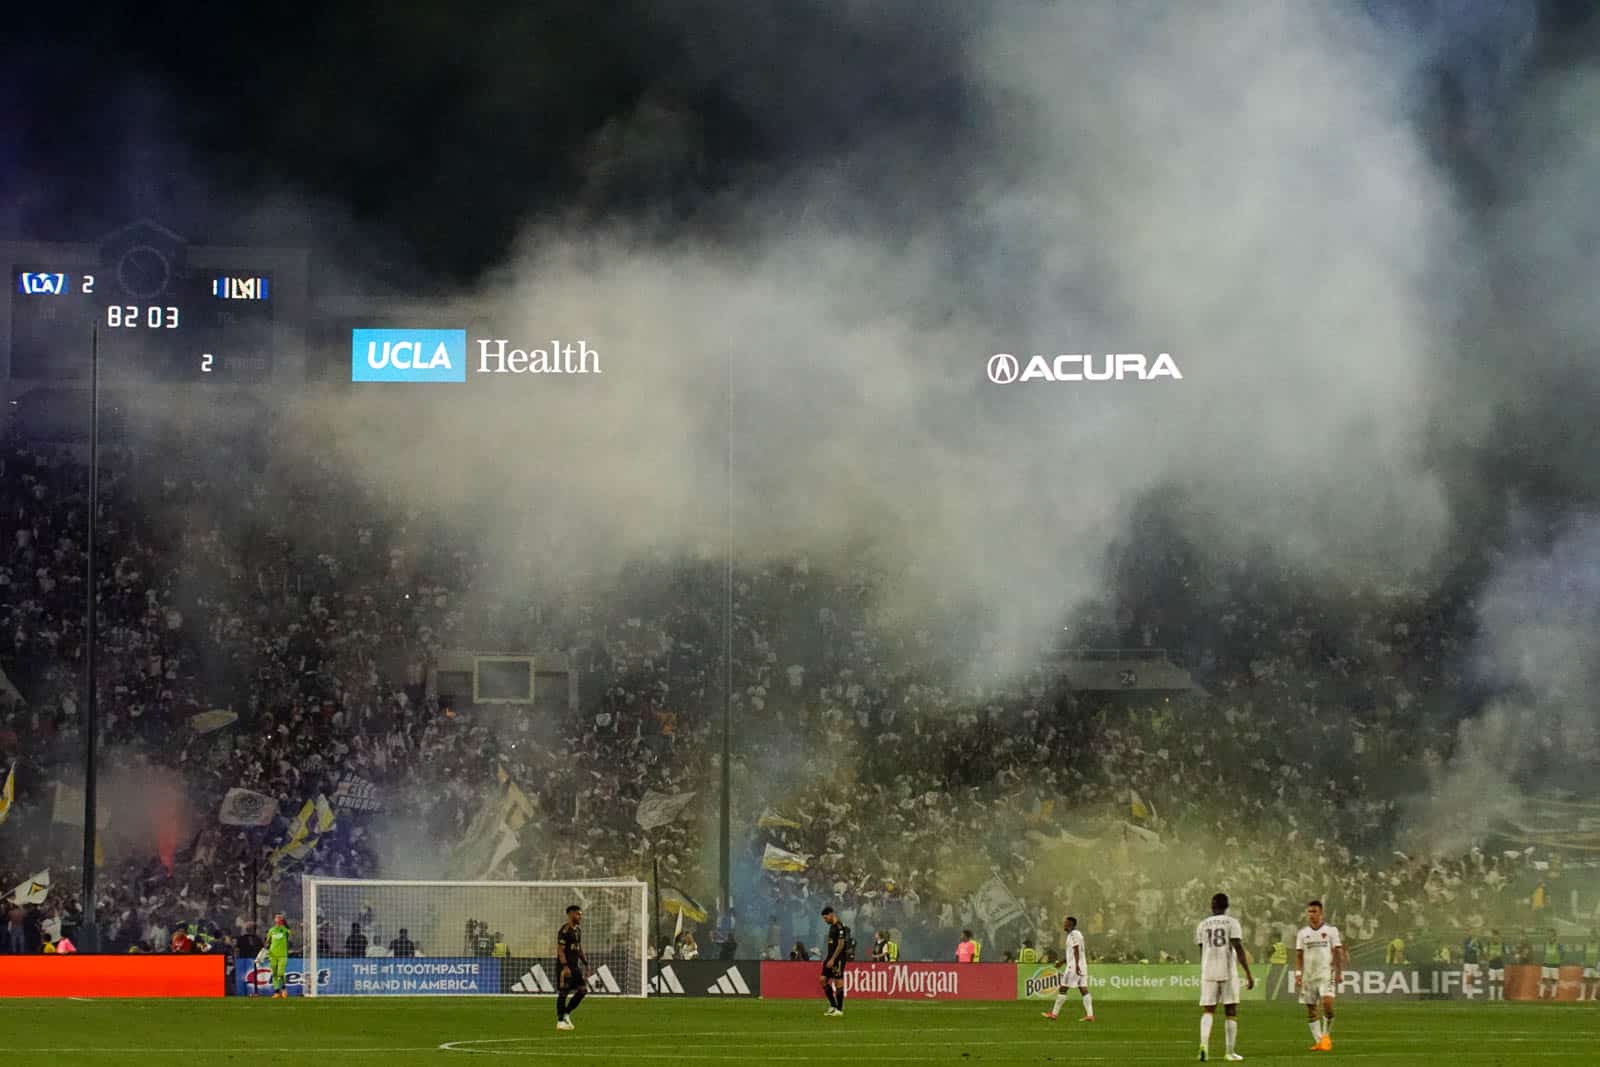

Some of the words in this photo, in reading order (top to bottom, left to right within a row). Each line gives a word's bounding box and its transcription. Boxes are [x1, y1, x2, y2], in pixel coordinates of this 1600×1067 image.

[82, 275, 94, 293] 2
[107, 305, 139, 328] 82
[147, 306, 179, 328] 03
[201, 354, 213, 372] 2
[367, 341, 452, 369] UCLA
[476, 339, 602, 374] Health
[1019, 353, 1183, 381] ACURA
[1205, 928, 1226, 947] 18
[352, 964, 377, 975] THE
[381, 964, 394, 975] #1
[396, 964, 479, 975] TOOTHPASTE
[353, 979, 400, 991] BRAND
[403, 979, 414, 990] IN
[418, 979, 477, 991] AMERICA
[843, 964, 888, 998] ptain
[888, 964, 958, 998] Morgan
[1026, 973, 1062, 996] Bount
[1110, 974, 1164, 988] Quicker
[1170, 974, 1202, 987] Pick
